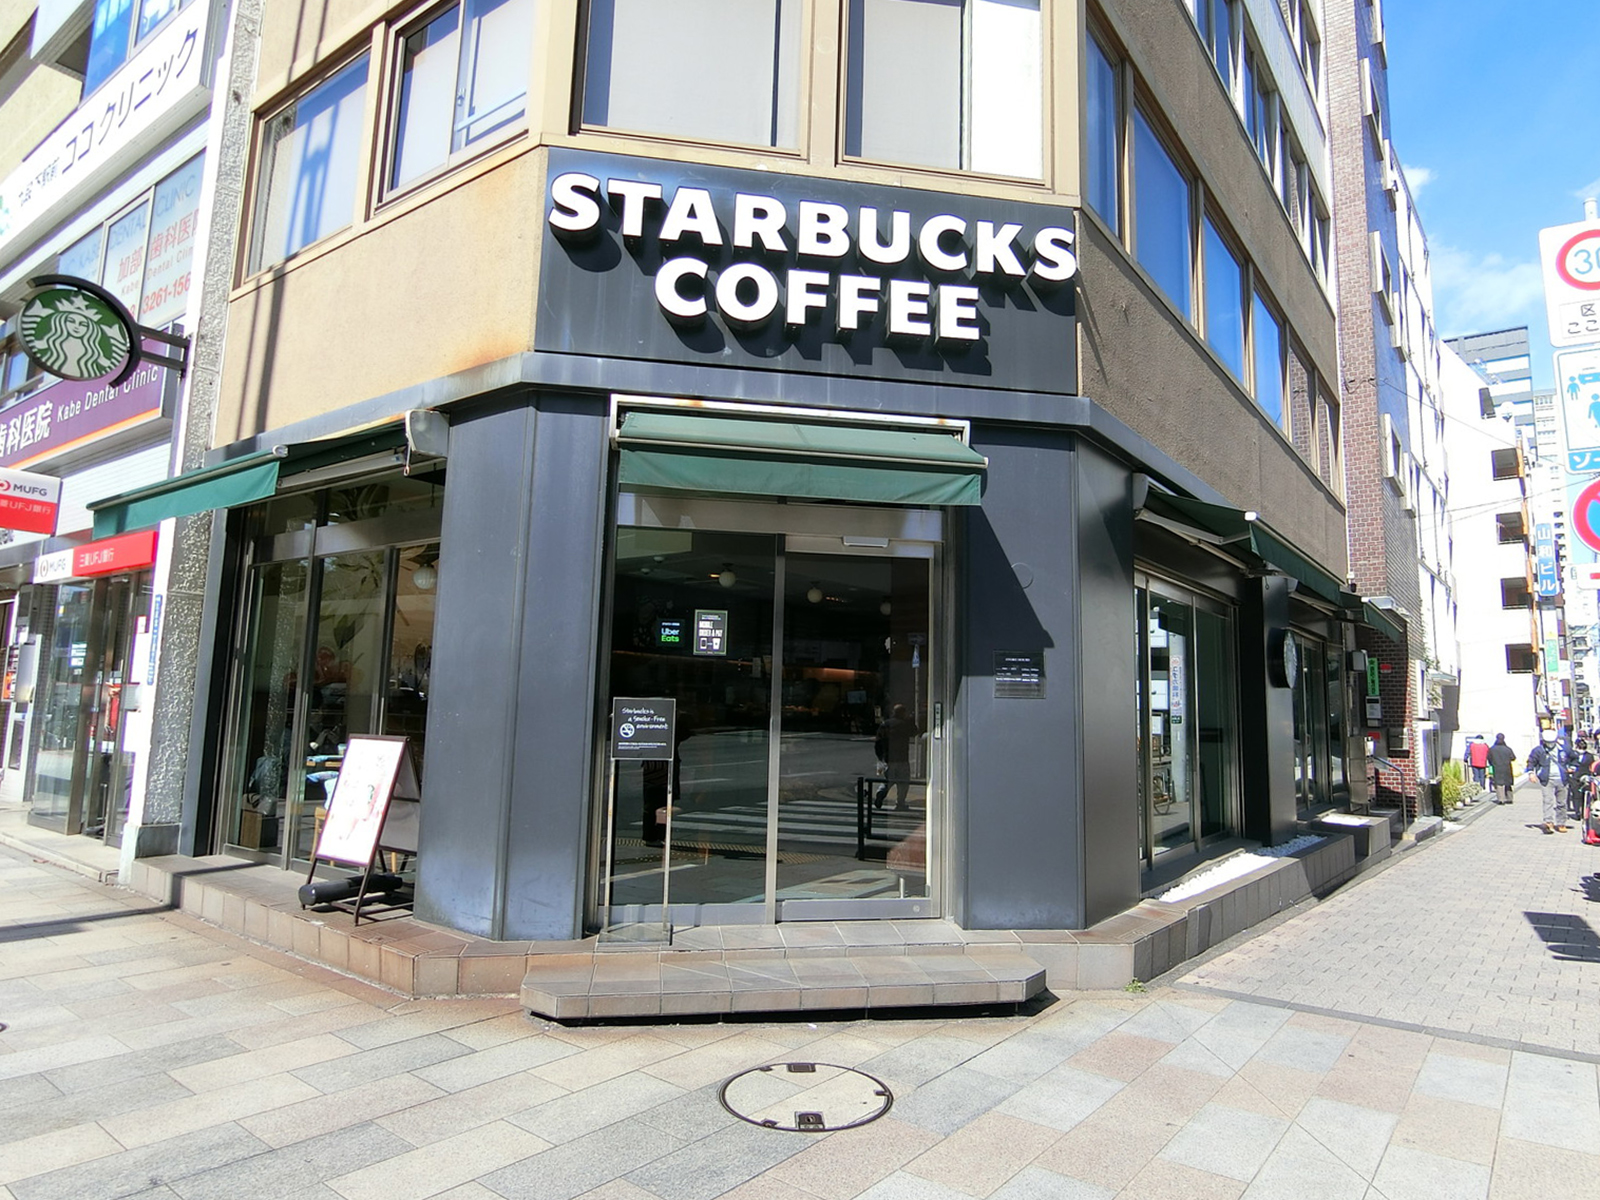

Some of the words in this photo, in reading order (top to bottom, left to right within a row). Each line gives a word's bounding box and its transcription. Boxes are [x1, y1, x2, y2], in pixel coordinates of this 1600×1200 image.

[62, 28, 198, 175] ココクリニック
[155, 175, 196, 217] CLINIC
[548, 172, 1077, 283] STARBUCKS
[654, 257, 980, 341] COFFEE
[56, 401, 82, 423] Kabe
[84, 380, 121, 411] Dental
[13, 483, 48, 497] MUFG
[661, 627, 680, 636] Uber
[661, 634, 680, 643] Eats
